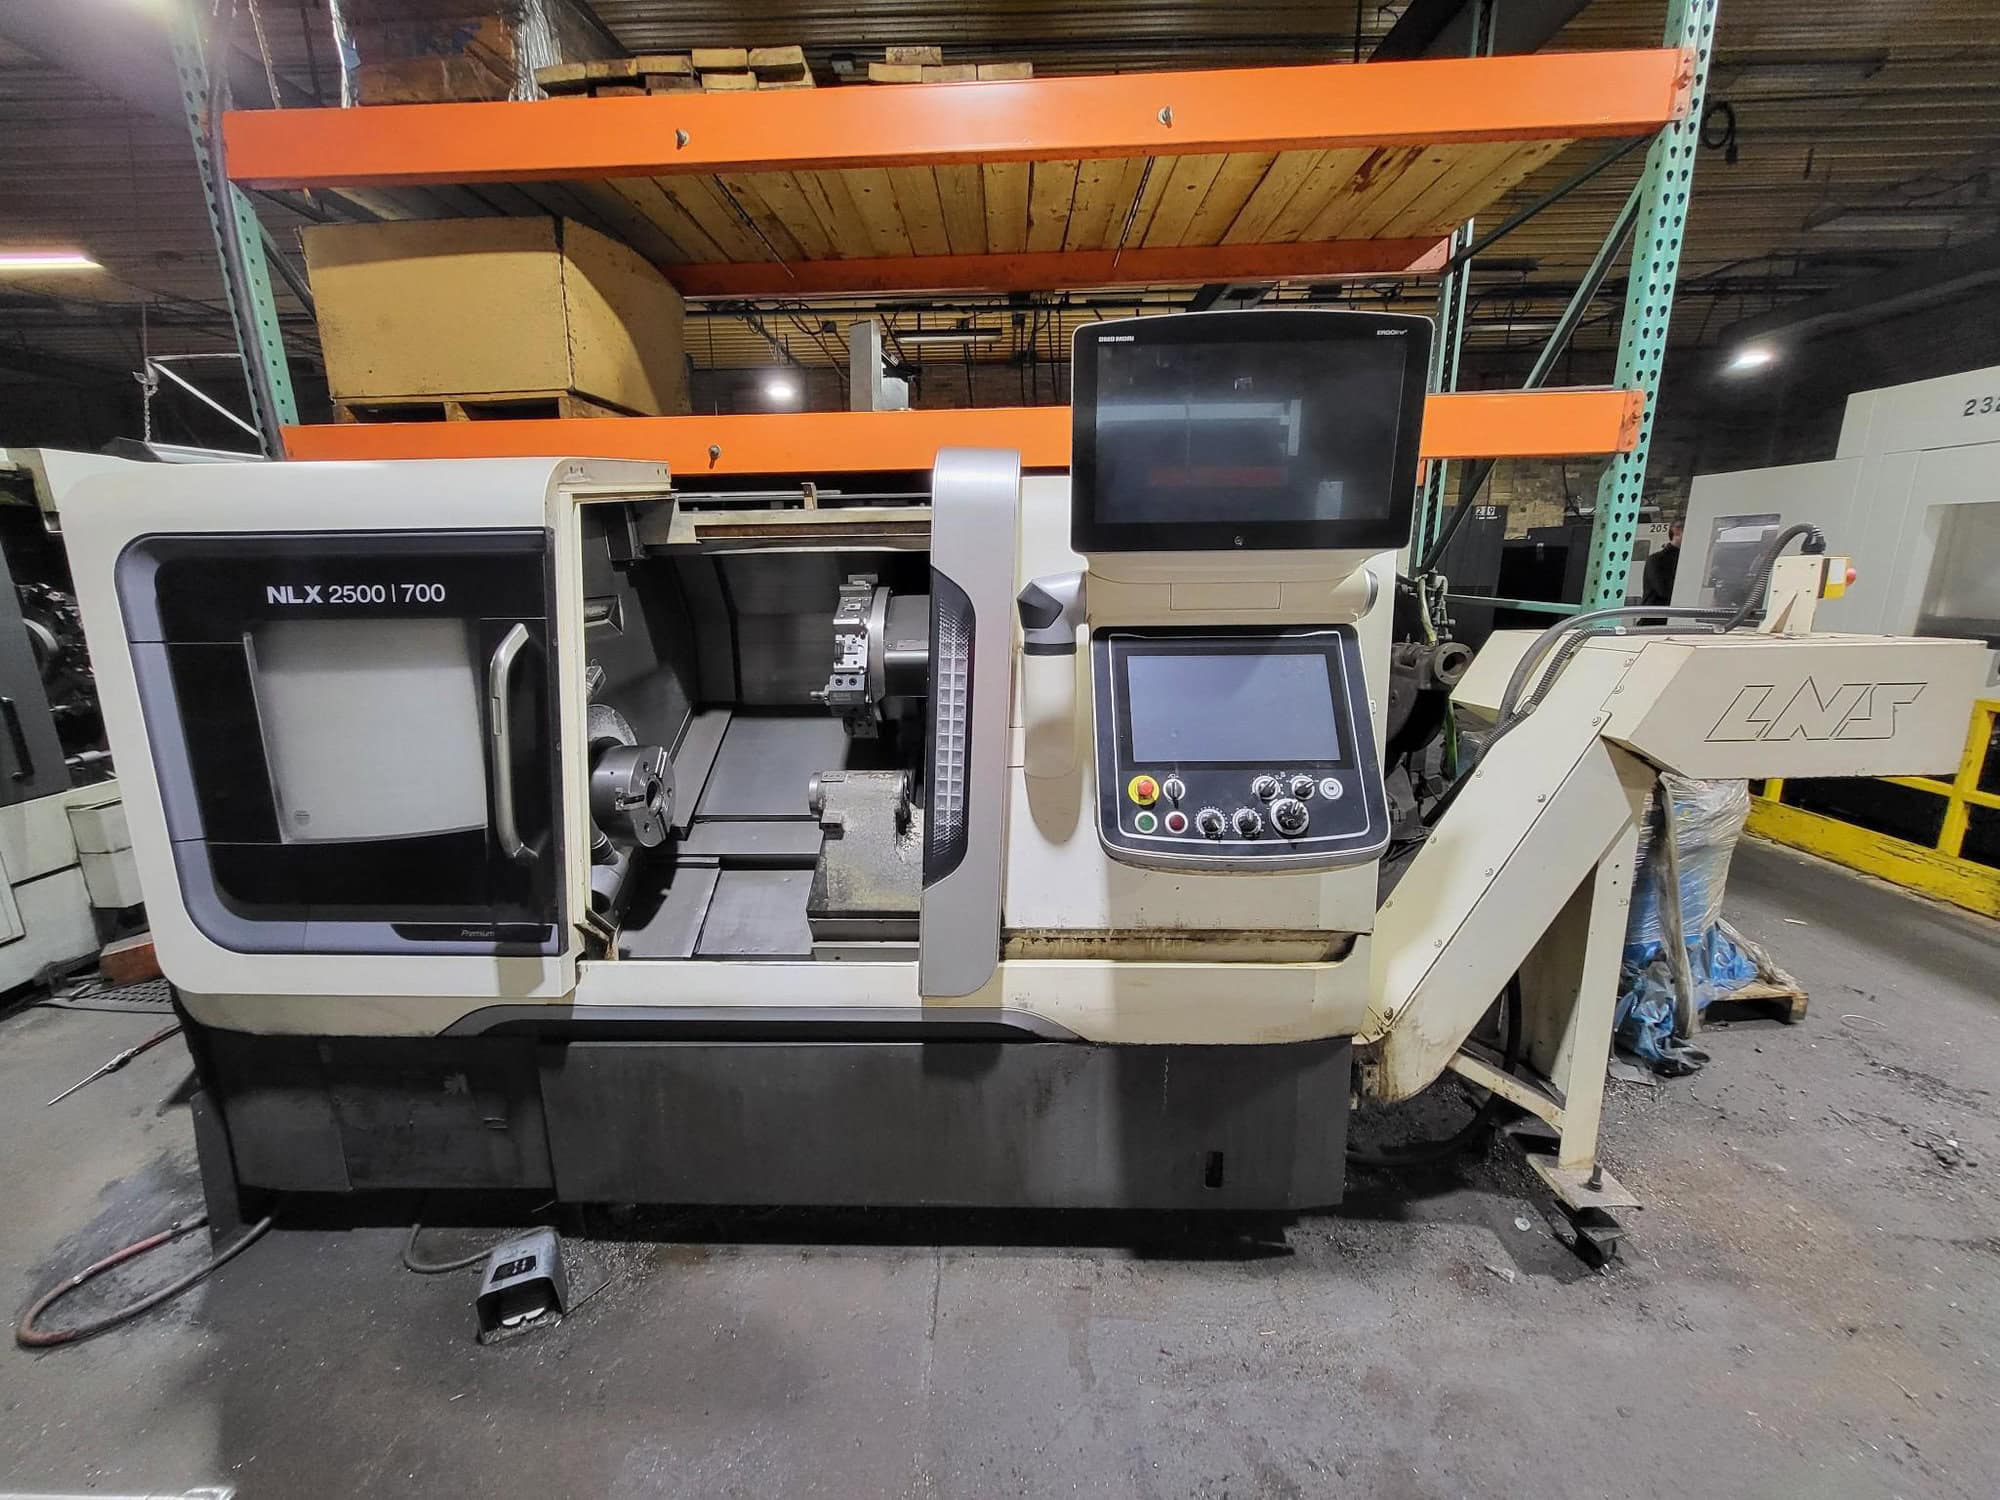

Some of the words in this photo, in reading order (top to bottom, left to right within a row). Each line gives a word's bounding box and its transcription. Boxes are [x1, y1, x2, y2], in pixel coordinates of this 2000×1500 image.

[1650, 524, 1668, 533] 205
[266, 585, 323, 604] NLX
[328, 584, 386, 604] 2500
[400, 583, 446, 603] 700
[1703, 675, 1928, 742] LNS
[461, 929, 495, 937] Premium
